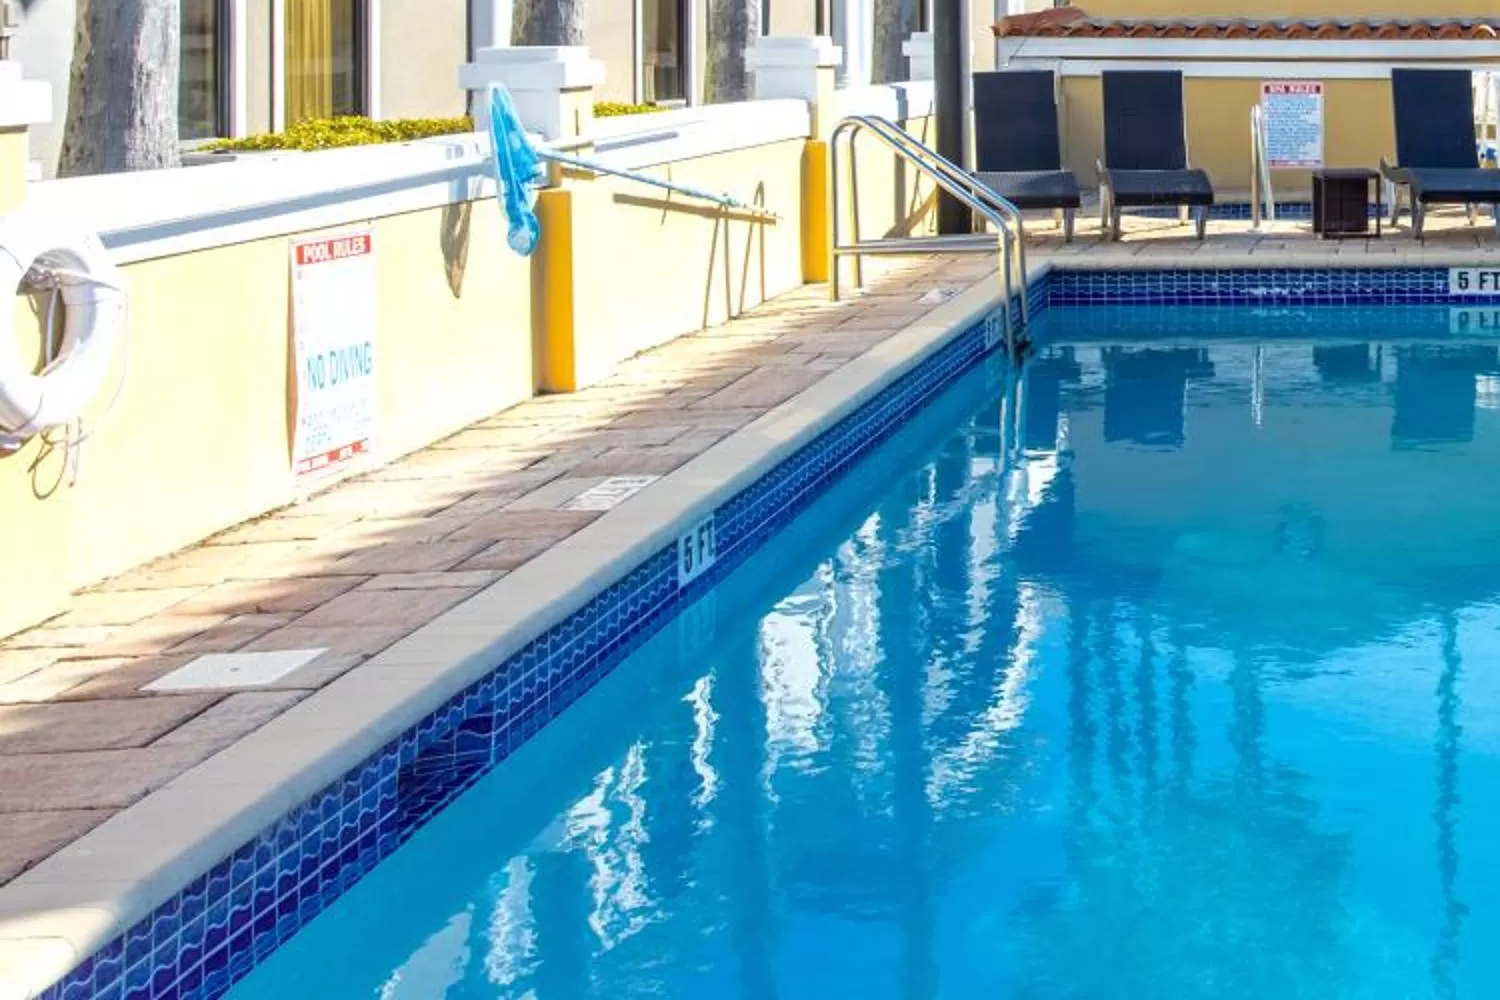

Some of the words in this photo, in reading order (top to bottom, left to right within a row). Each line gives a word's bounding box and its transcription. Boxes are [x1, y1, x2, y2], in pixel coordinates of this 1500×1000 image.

[304, 242, 331, 263] POOL
[334, 237, 366, 258] RULES
[1458, 271, 1469, 290] 5
[306, 353, 325, 391] NO
[329, 340, 373, 385] DIVING
